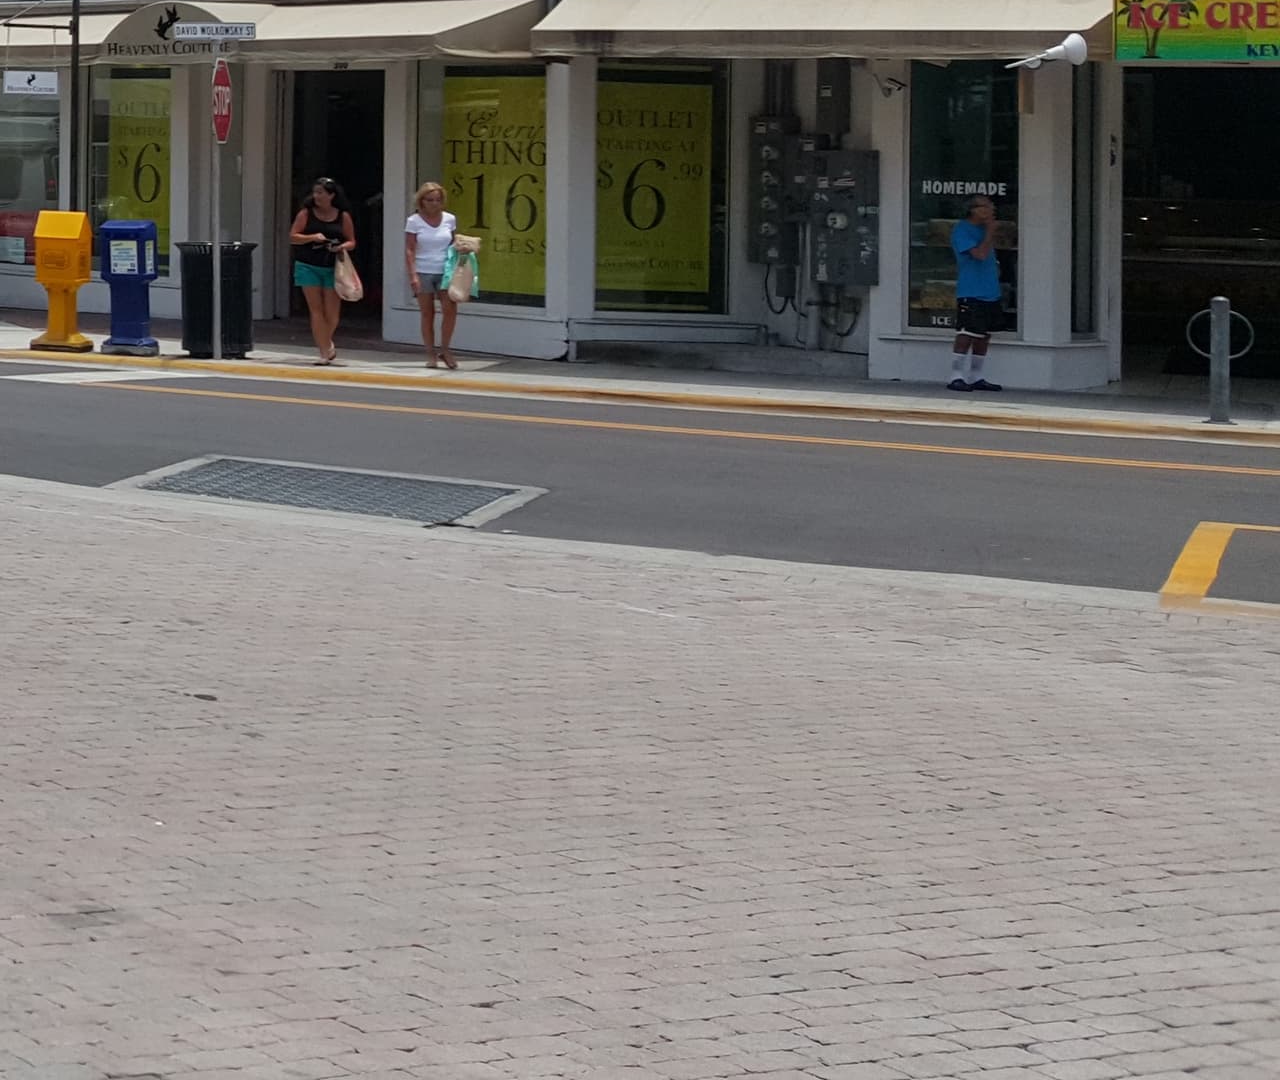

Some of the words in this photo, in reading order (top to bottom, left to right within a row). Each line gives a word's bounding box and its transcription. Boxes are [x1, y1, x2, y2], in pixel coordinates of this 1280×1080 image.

[1129, 1, 1190, 29] ICE
[175, 26, 197, 35] DAVID
[246, 26, 255, 35] ST
[107, 42, 169, 56] HEAVENLY
[214, 86, 231, 116] STOP
[597, 109, 700, 129] OUTLET
[445, 139, 546, 167] THING
[922, 180, 1007, 196] HOMEMADE
[932, 316, 952, 326] ICE
